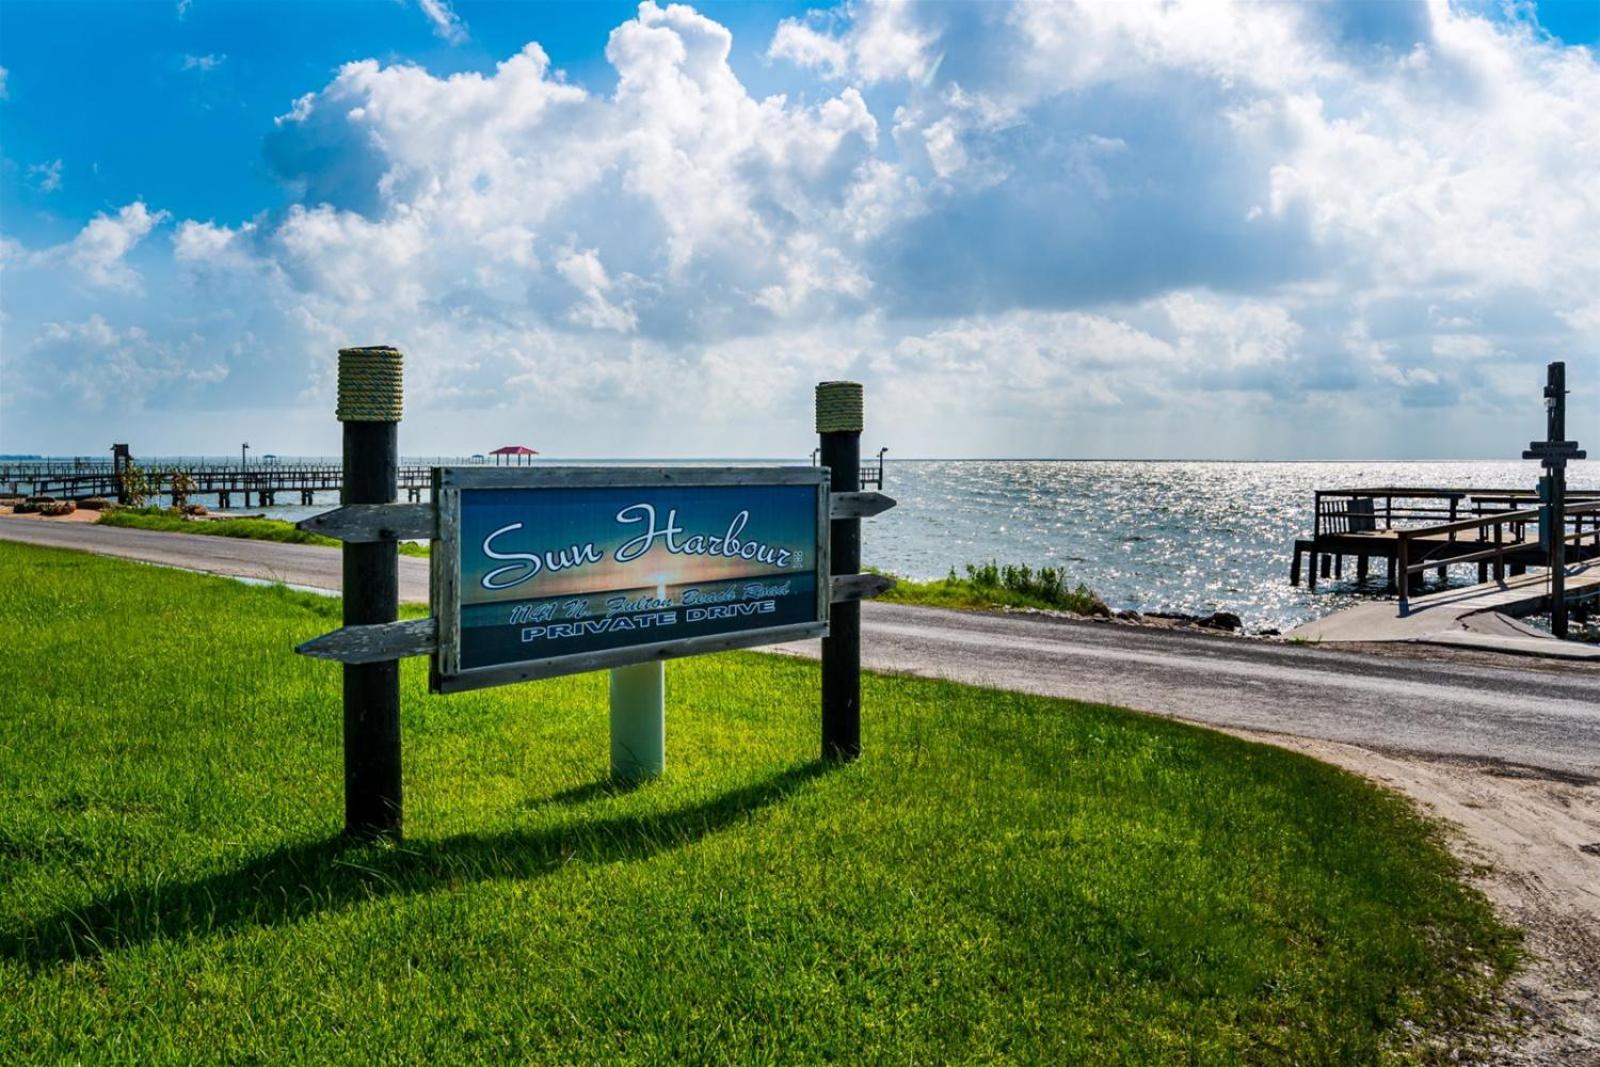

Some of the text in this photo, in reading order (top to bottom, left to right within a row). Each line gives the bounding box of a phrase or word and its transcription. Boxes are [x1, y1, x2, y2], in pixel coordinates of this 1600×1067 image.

[481, 503, 794, 590] Sun Harbour
[681, 583, 737, 606] Beach
[742, 580, 792, 600] Road
[521, 600, 775, 642] PRIVATE DRIVE
